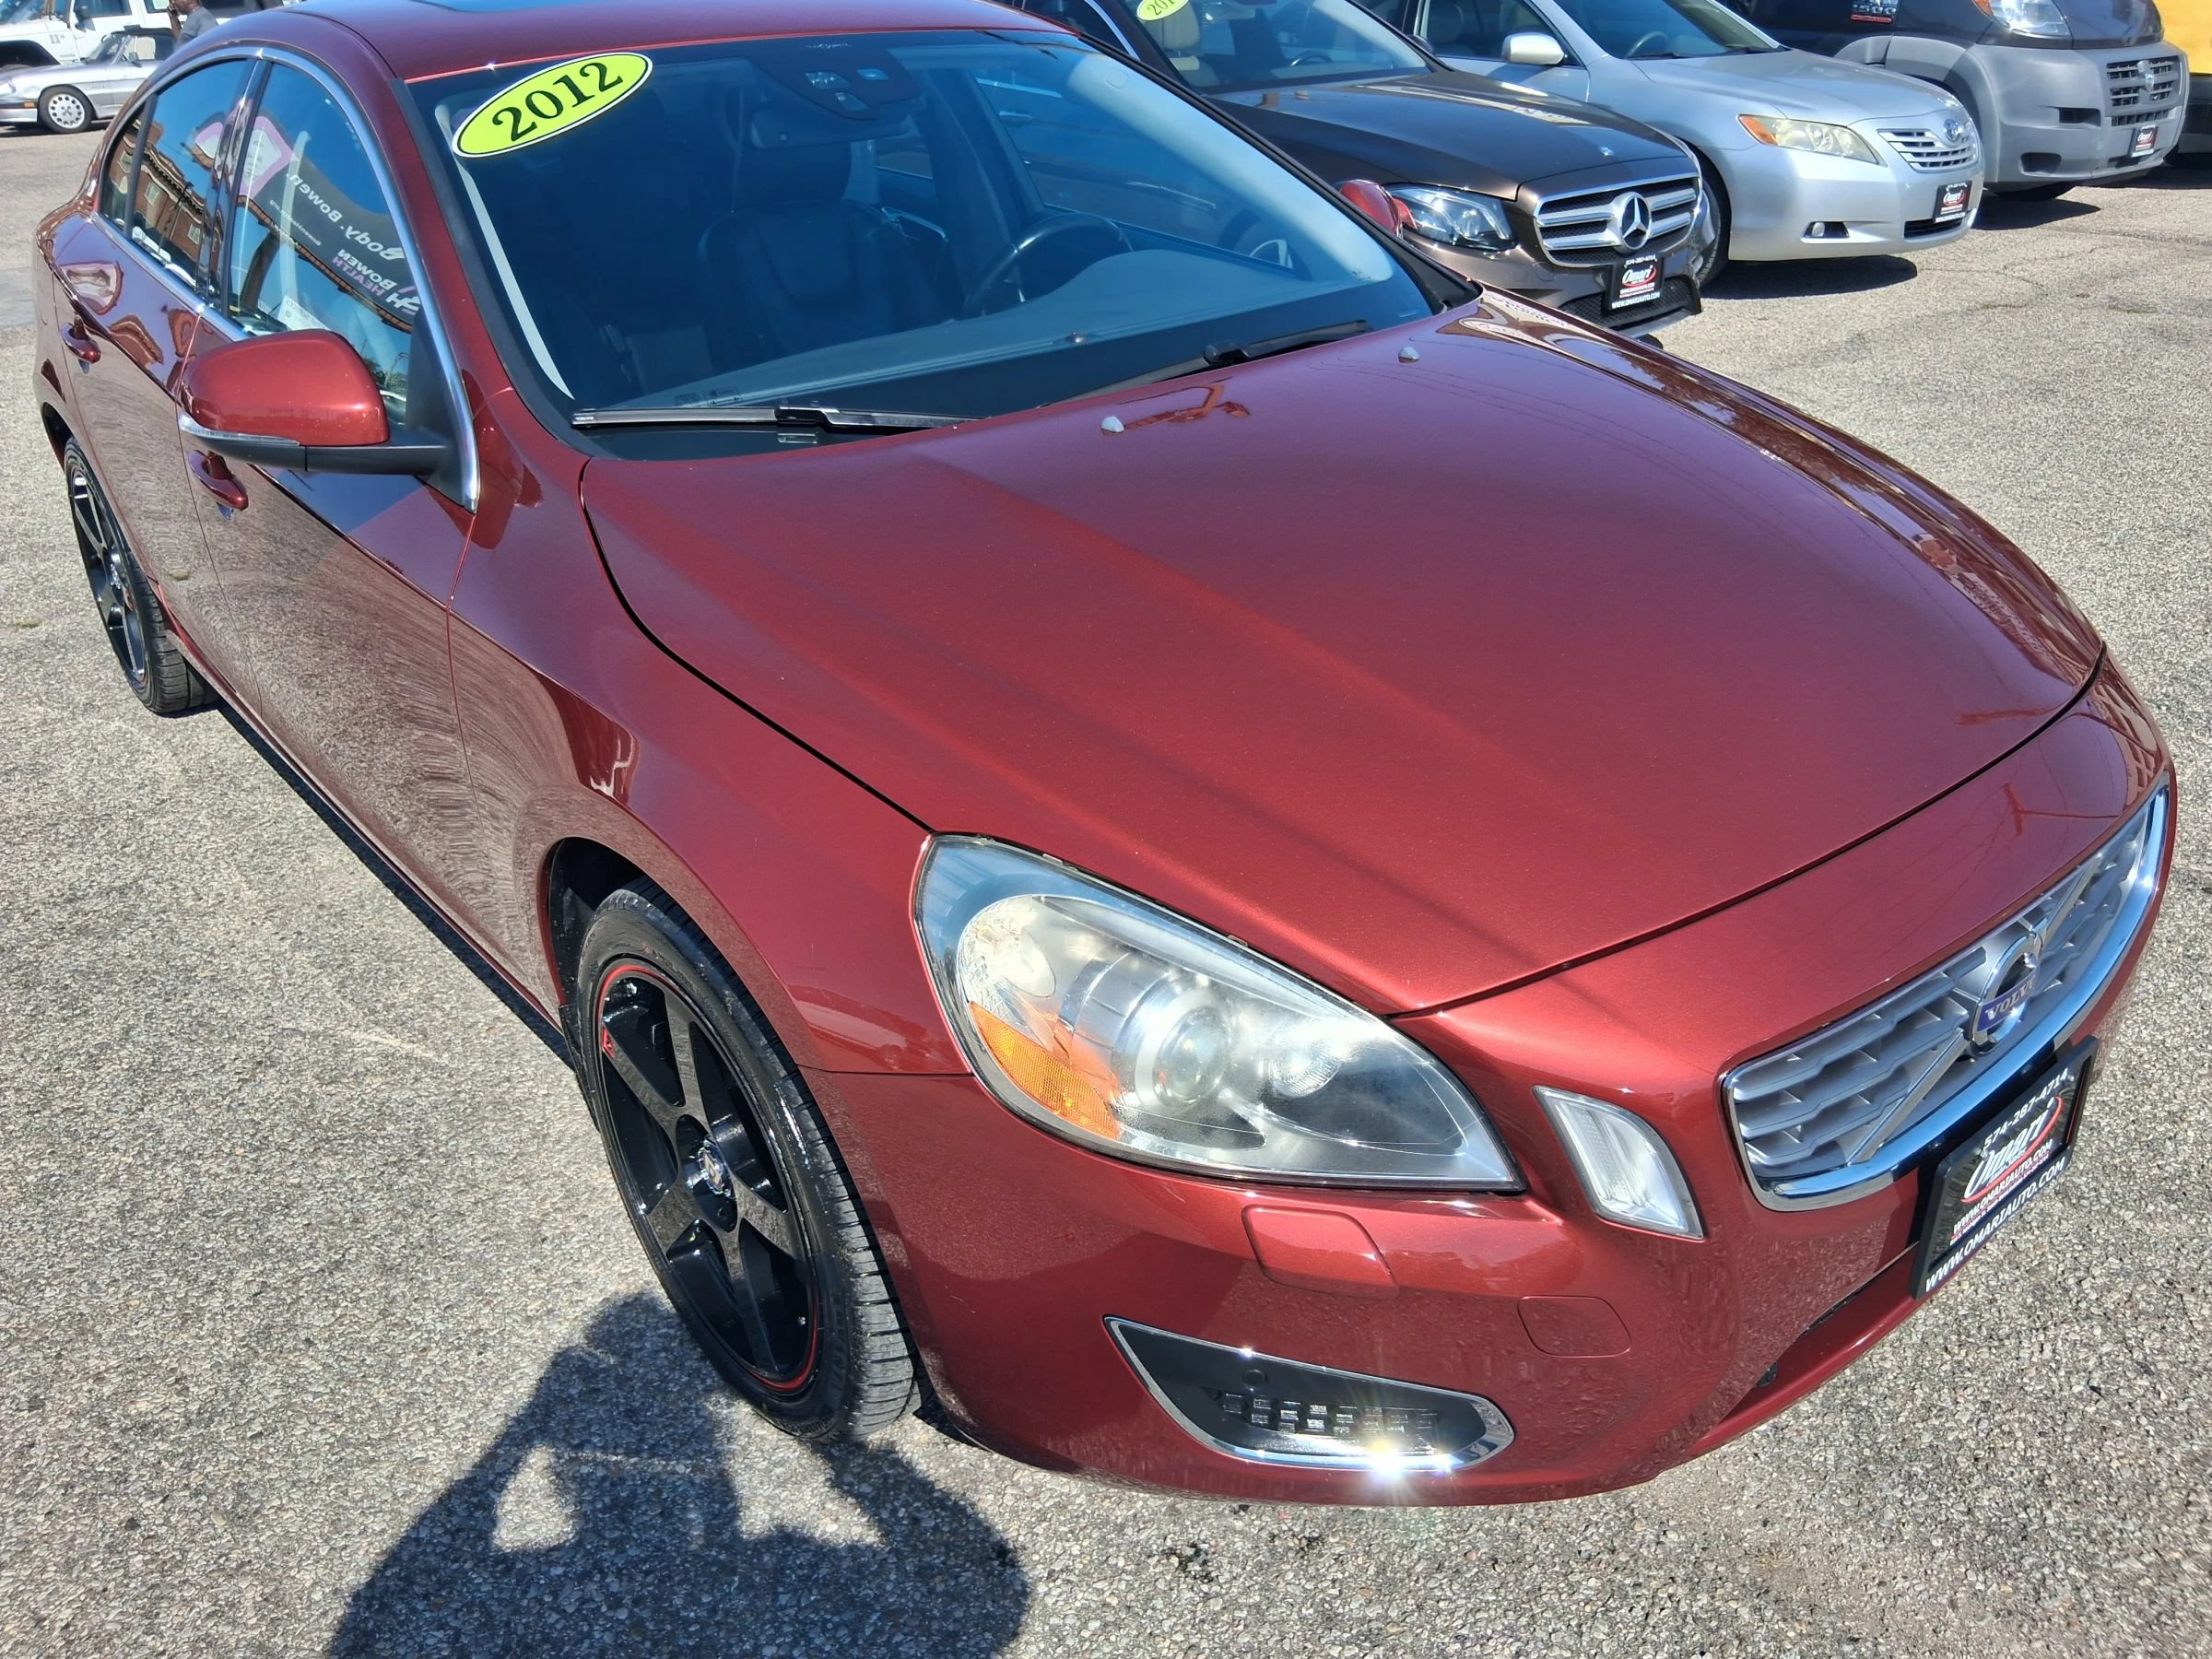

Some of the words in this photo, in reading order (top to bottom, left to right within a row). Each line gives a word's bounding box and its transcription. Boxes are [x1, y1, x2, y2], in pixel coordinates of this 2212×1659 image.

[492, 62, 624, 142] 2012
[1984, 1067, 2068, 1148] 574-287-4714
[1925, 1157, 2065, 1292] WWW.OMARIAUTO.COM
